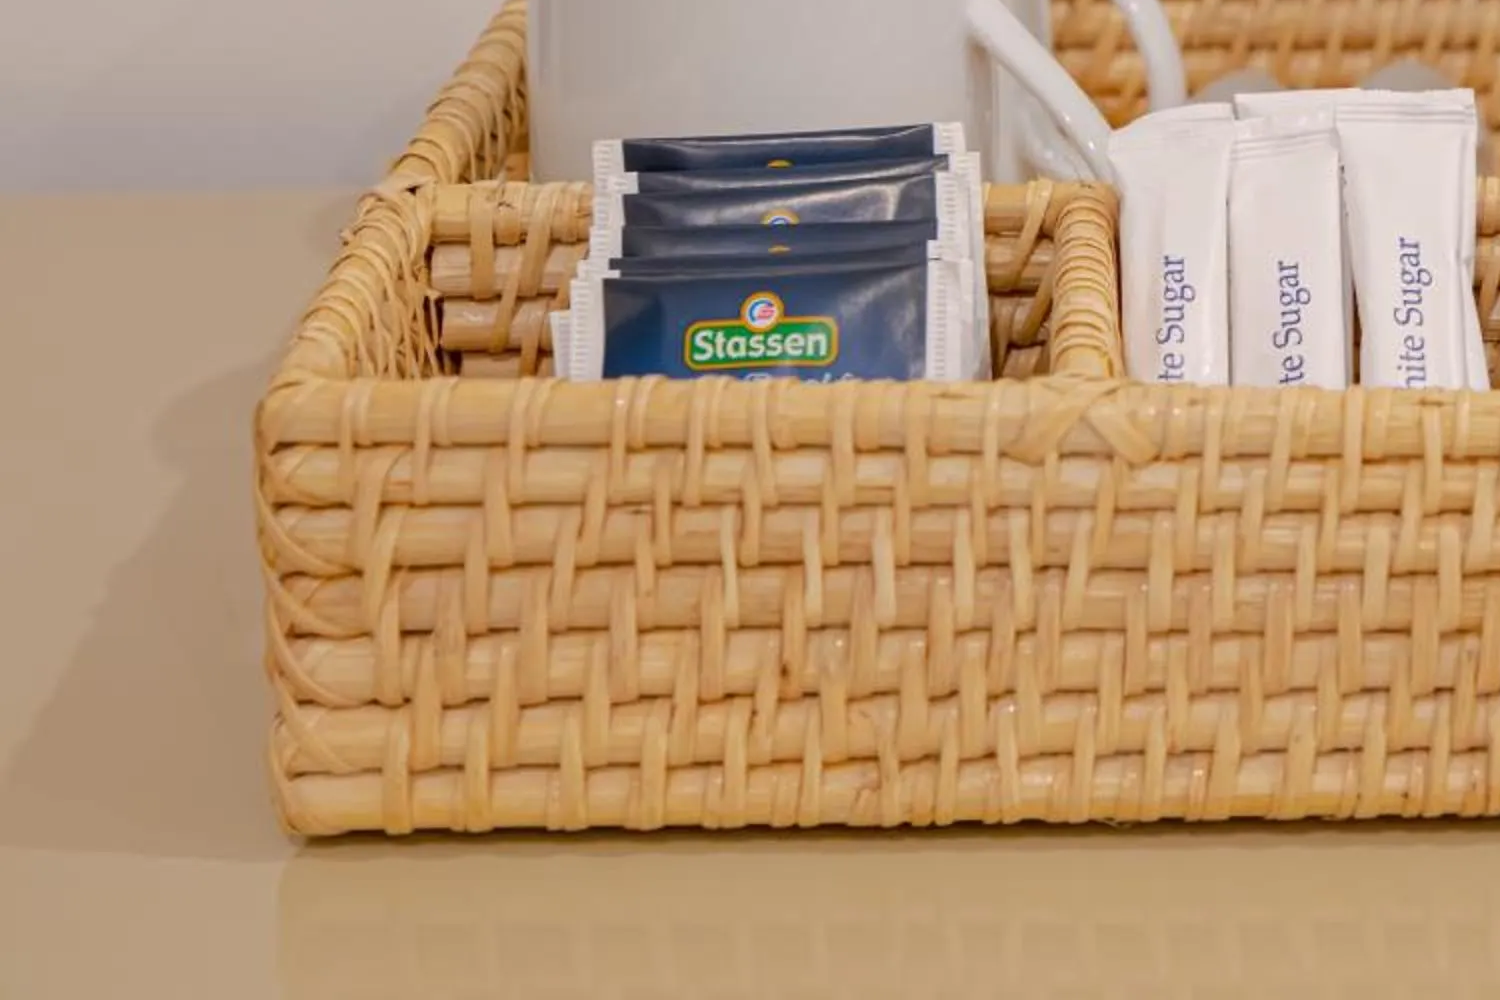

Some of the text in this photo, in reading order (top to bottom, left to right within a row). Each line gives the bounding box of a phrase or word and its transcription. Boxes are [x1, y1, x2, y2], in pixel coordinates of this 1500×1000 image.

[1156, 255, 1196, 345] Sugar
[1273, 260, 1311, 350] Sugar
[1393, 236, 1433, 326] Sugar
[692, 330, 827, 361] Stassen
